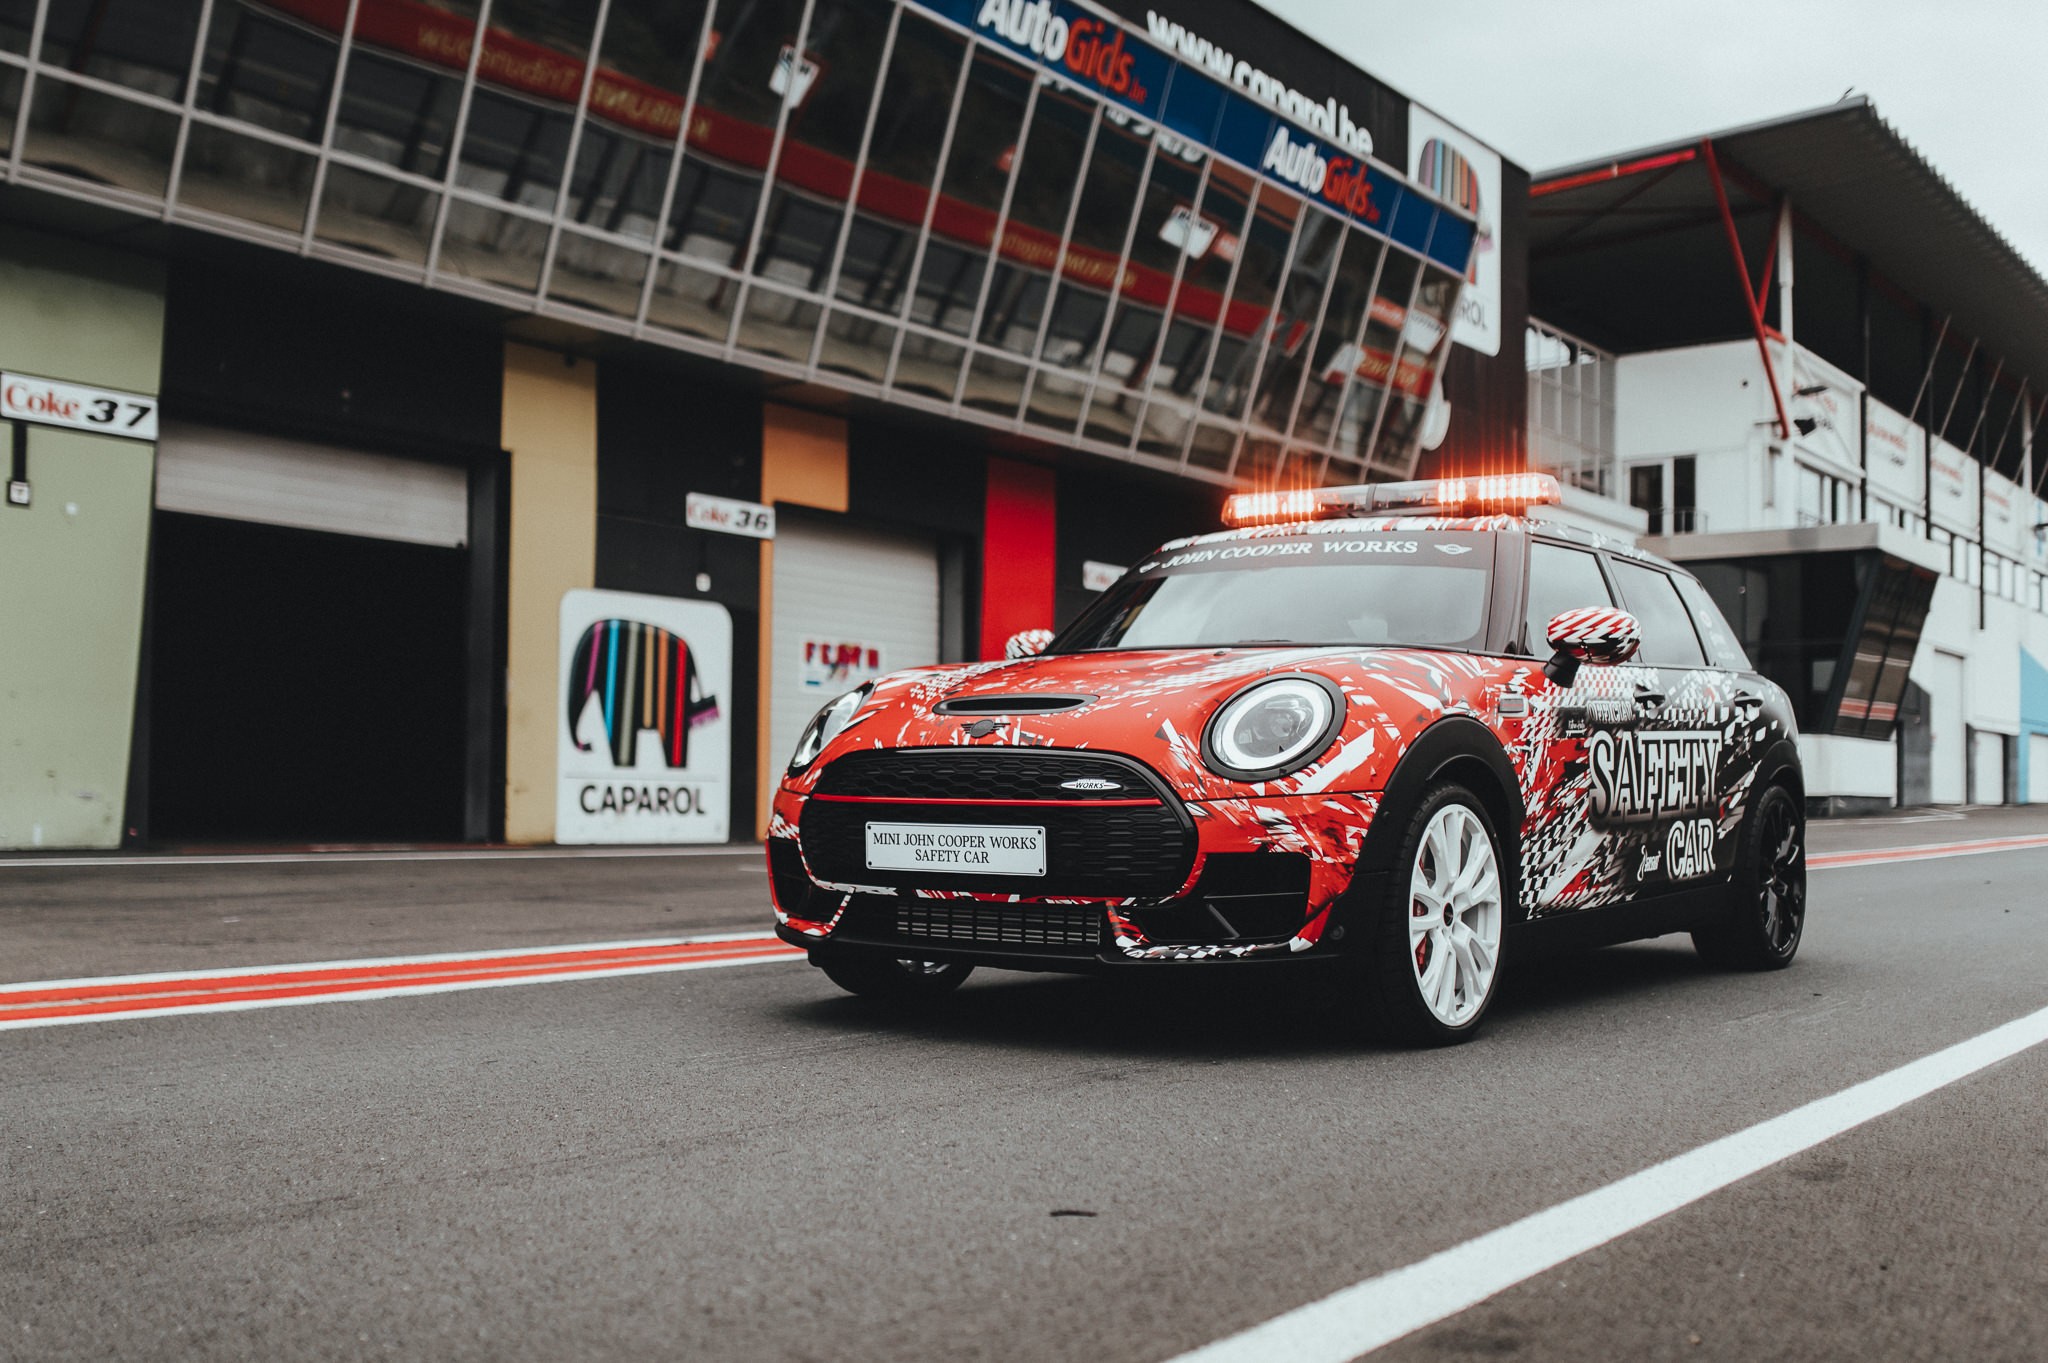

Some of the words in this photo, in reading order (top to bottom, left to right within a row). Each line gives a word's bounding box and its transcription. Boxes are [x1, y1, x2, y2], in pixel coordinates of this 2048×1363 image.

[1146, 9, 1373, 154] wwwcaarolbe
[5, 383, 80, 422] Coke
[86, 399, 152, 428] 37
[734, 510, 769, 531] 36
[1161, 549, 1222, 569] JOHN
[1220, 542, 1313, 560] COOPER
[1323, 540, 1419, 554] WORKS
[1589, 730, 1722, 824] SAFETY
[579, 785, 706, 815] CAPAROL
[873, 832, 900, 845] MINI
[904, 833, 934, 847] JOHN
[938, 835, 985, 848] COOPER
[989, 836, 1037, 850] WORKS
[915, 848, 960, 863] SAFETY
[964, 850, 990, 864] CAR
[1667, 818, 1717, 881] CAR
